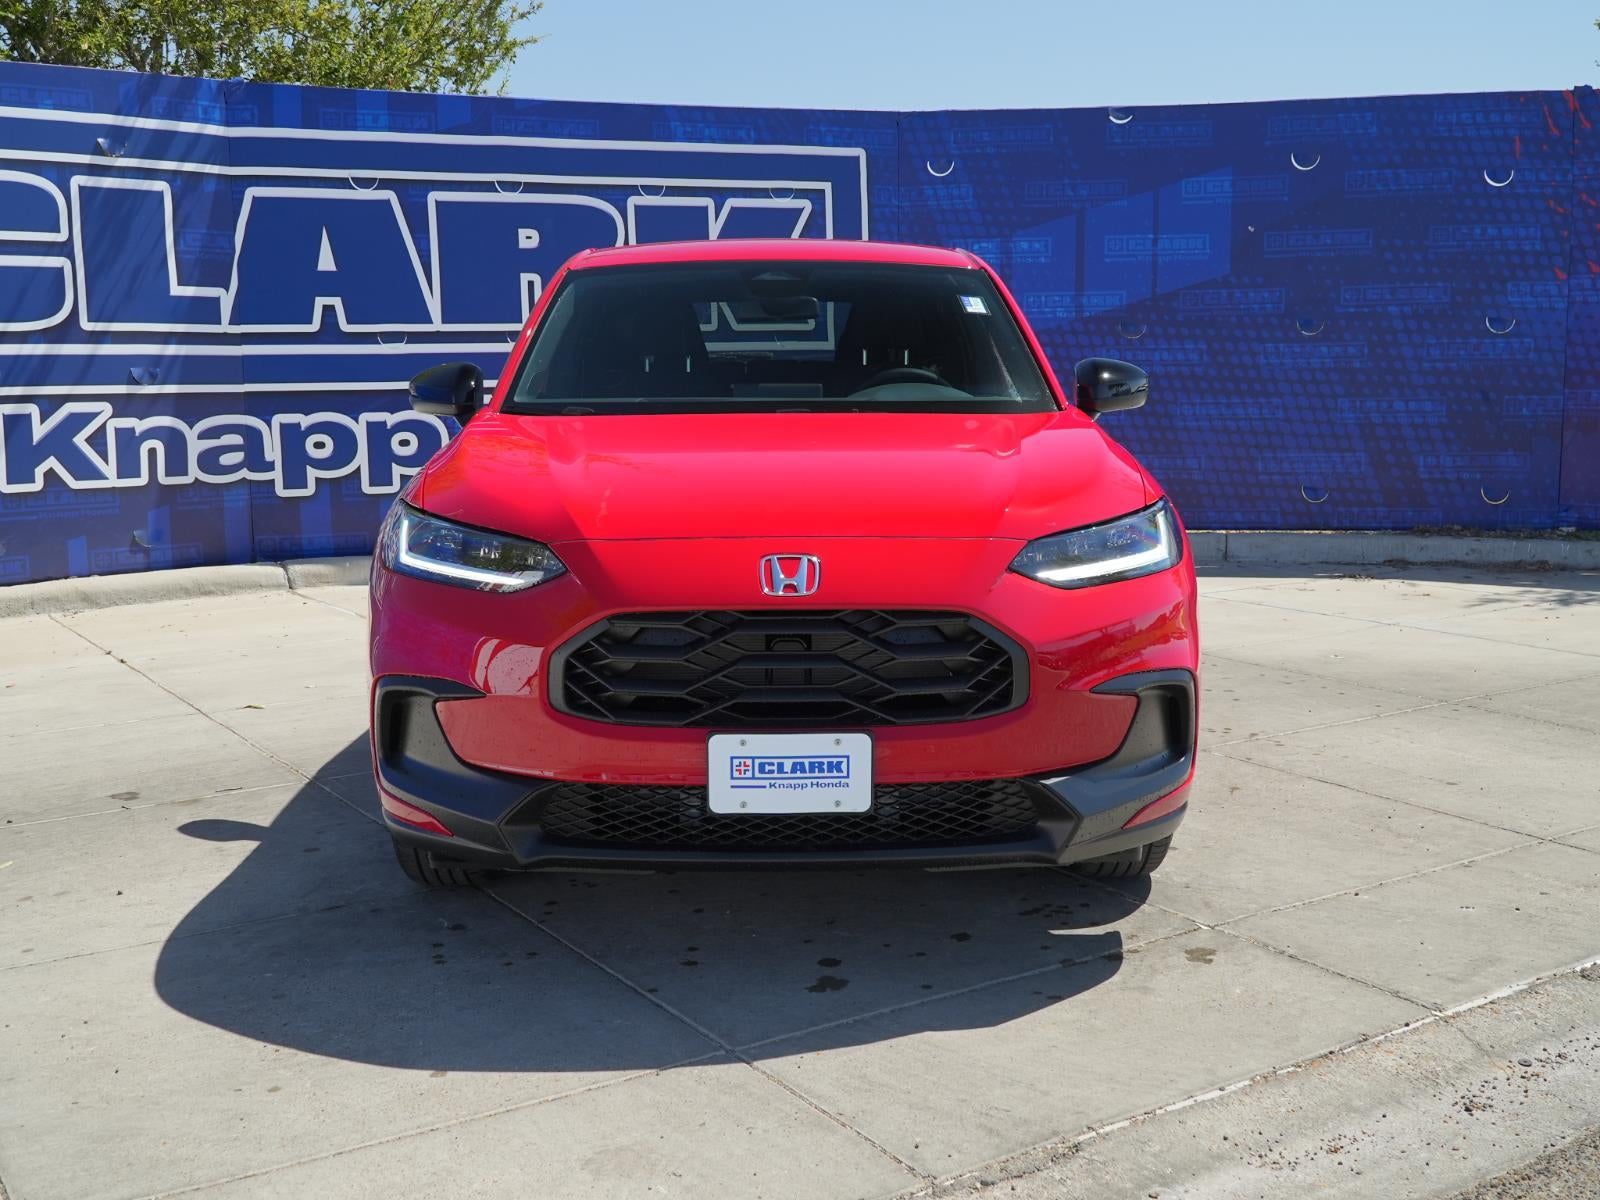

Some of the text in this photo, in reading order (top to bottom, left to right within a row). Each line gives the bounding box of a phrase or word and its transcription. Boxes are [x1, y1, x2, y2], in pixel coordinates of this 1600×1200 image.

[0, 402, 450, 497] Knapp
[758, 760, 844, 775] CLARK
[768, 780, 850, 790] Knapp Honda
